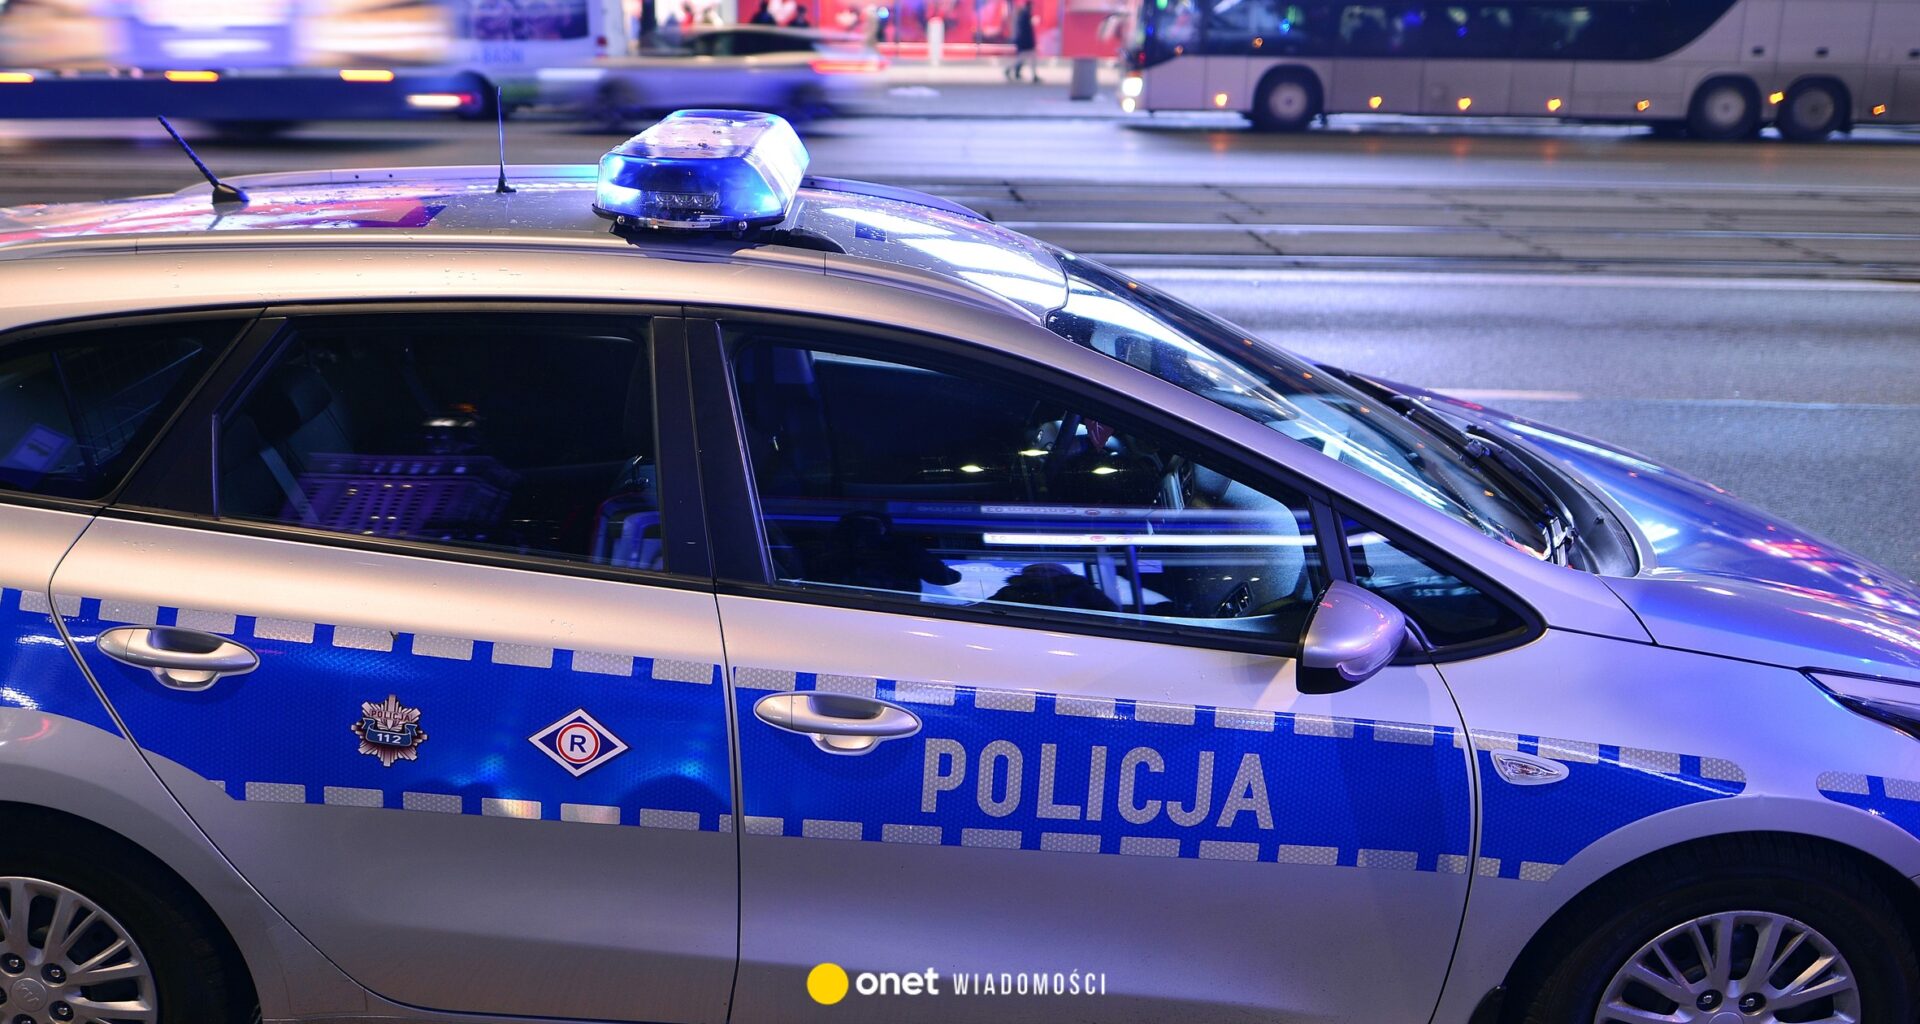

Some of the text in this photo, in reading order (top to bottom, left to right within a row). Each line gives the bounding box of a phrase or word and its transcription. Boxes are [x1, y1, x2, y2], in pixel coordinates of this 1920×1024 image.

[371, 710, 411, 722] POLICJA
[377, 733, 402, 744] 112
[569, 734, 587, 753] R
[920, 737, 1275, 830] POLICJA
